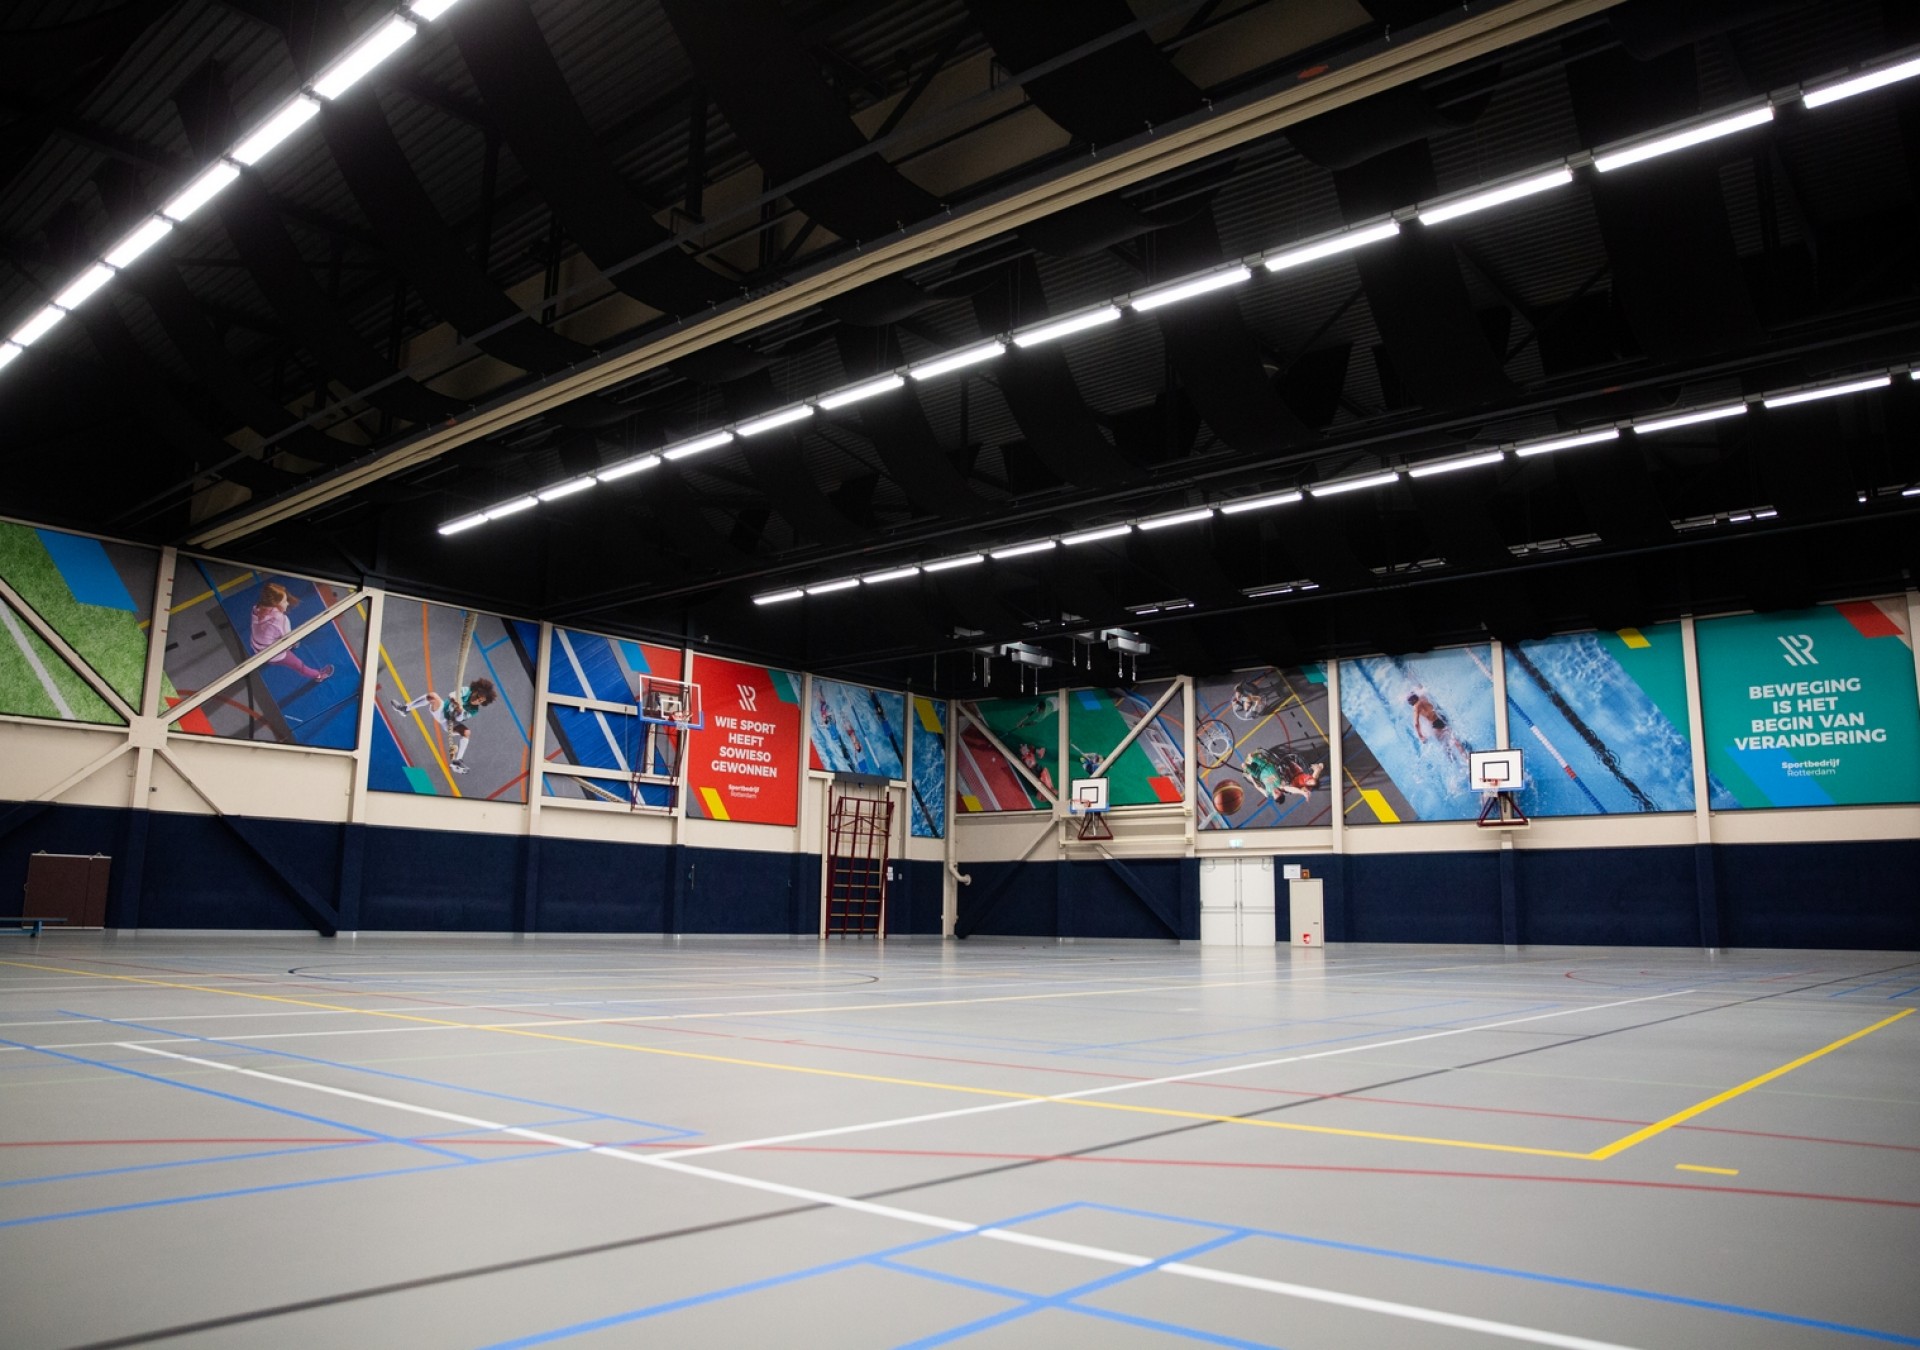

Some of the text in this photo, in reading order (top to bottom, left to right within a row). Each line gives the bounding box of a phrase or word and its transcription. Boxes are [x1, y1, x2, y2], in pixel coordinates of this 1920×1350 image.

[1749, 677, 1861, 699] BEWEGING
[1773, 696, 1838, 715] IS HET
[715, 716, 776, 734] WIE SPORT
[1751, 712, 1865, 732] BEGIN VAN
[728, 732, 764, 746] HEEFT
[1734, 728, 1887, 751] VERANDERING
[719, 746, 771, 762] SOWIESO
[711, 760, 777, 777] GEWONNEN
[1781, 758, 1840, 771] Sportbedrijf
[1786, 767, 1836, 777] Rotterdam
